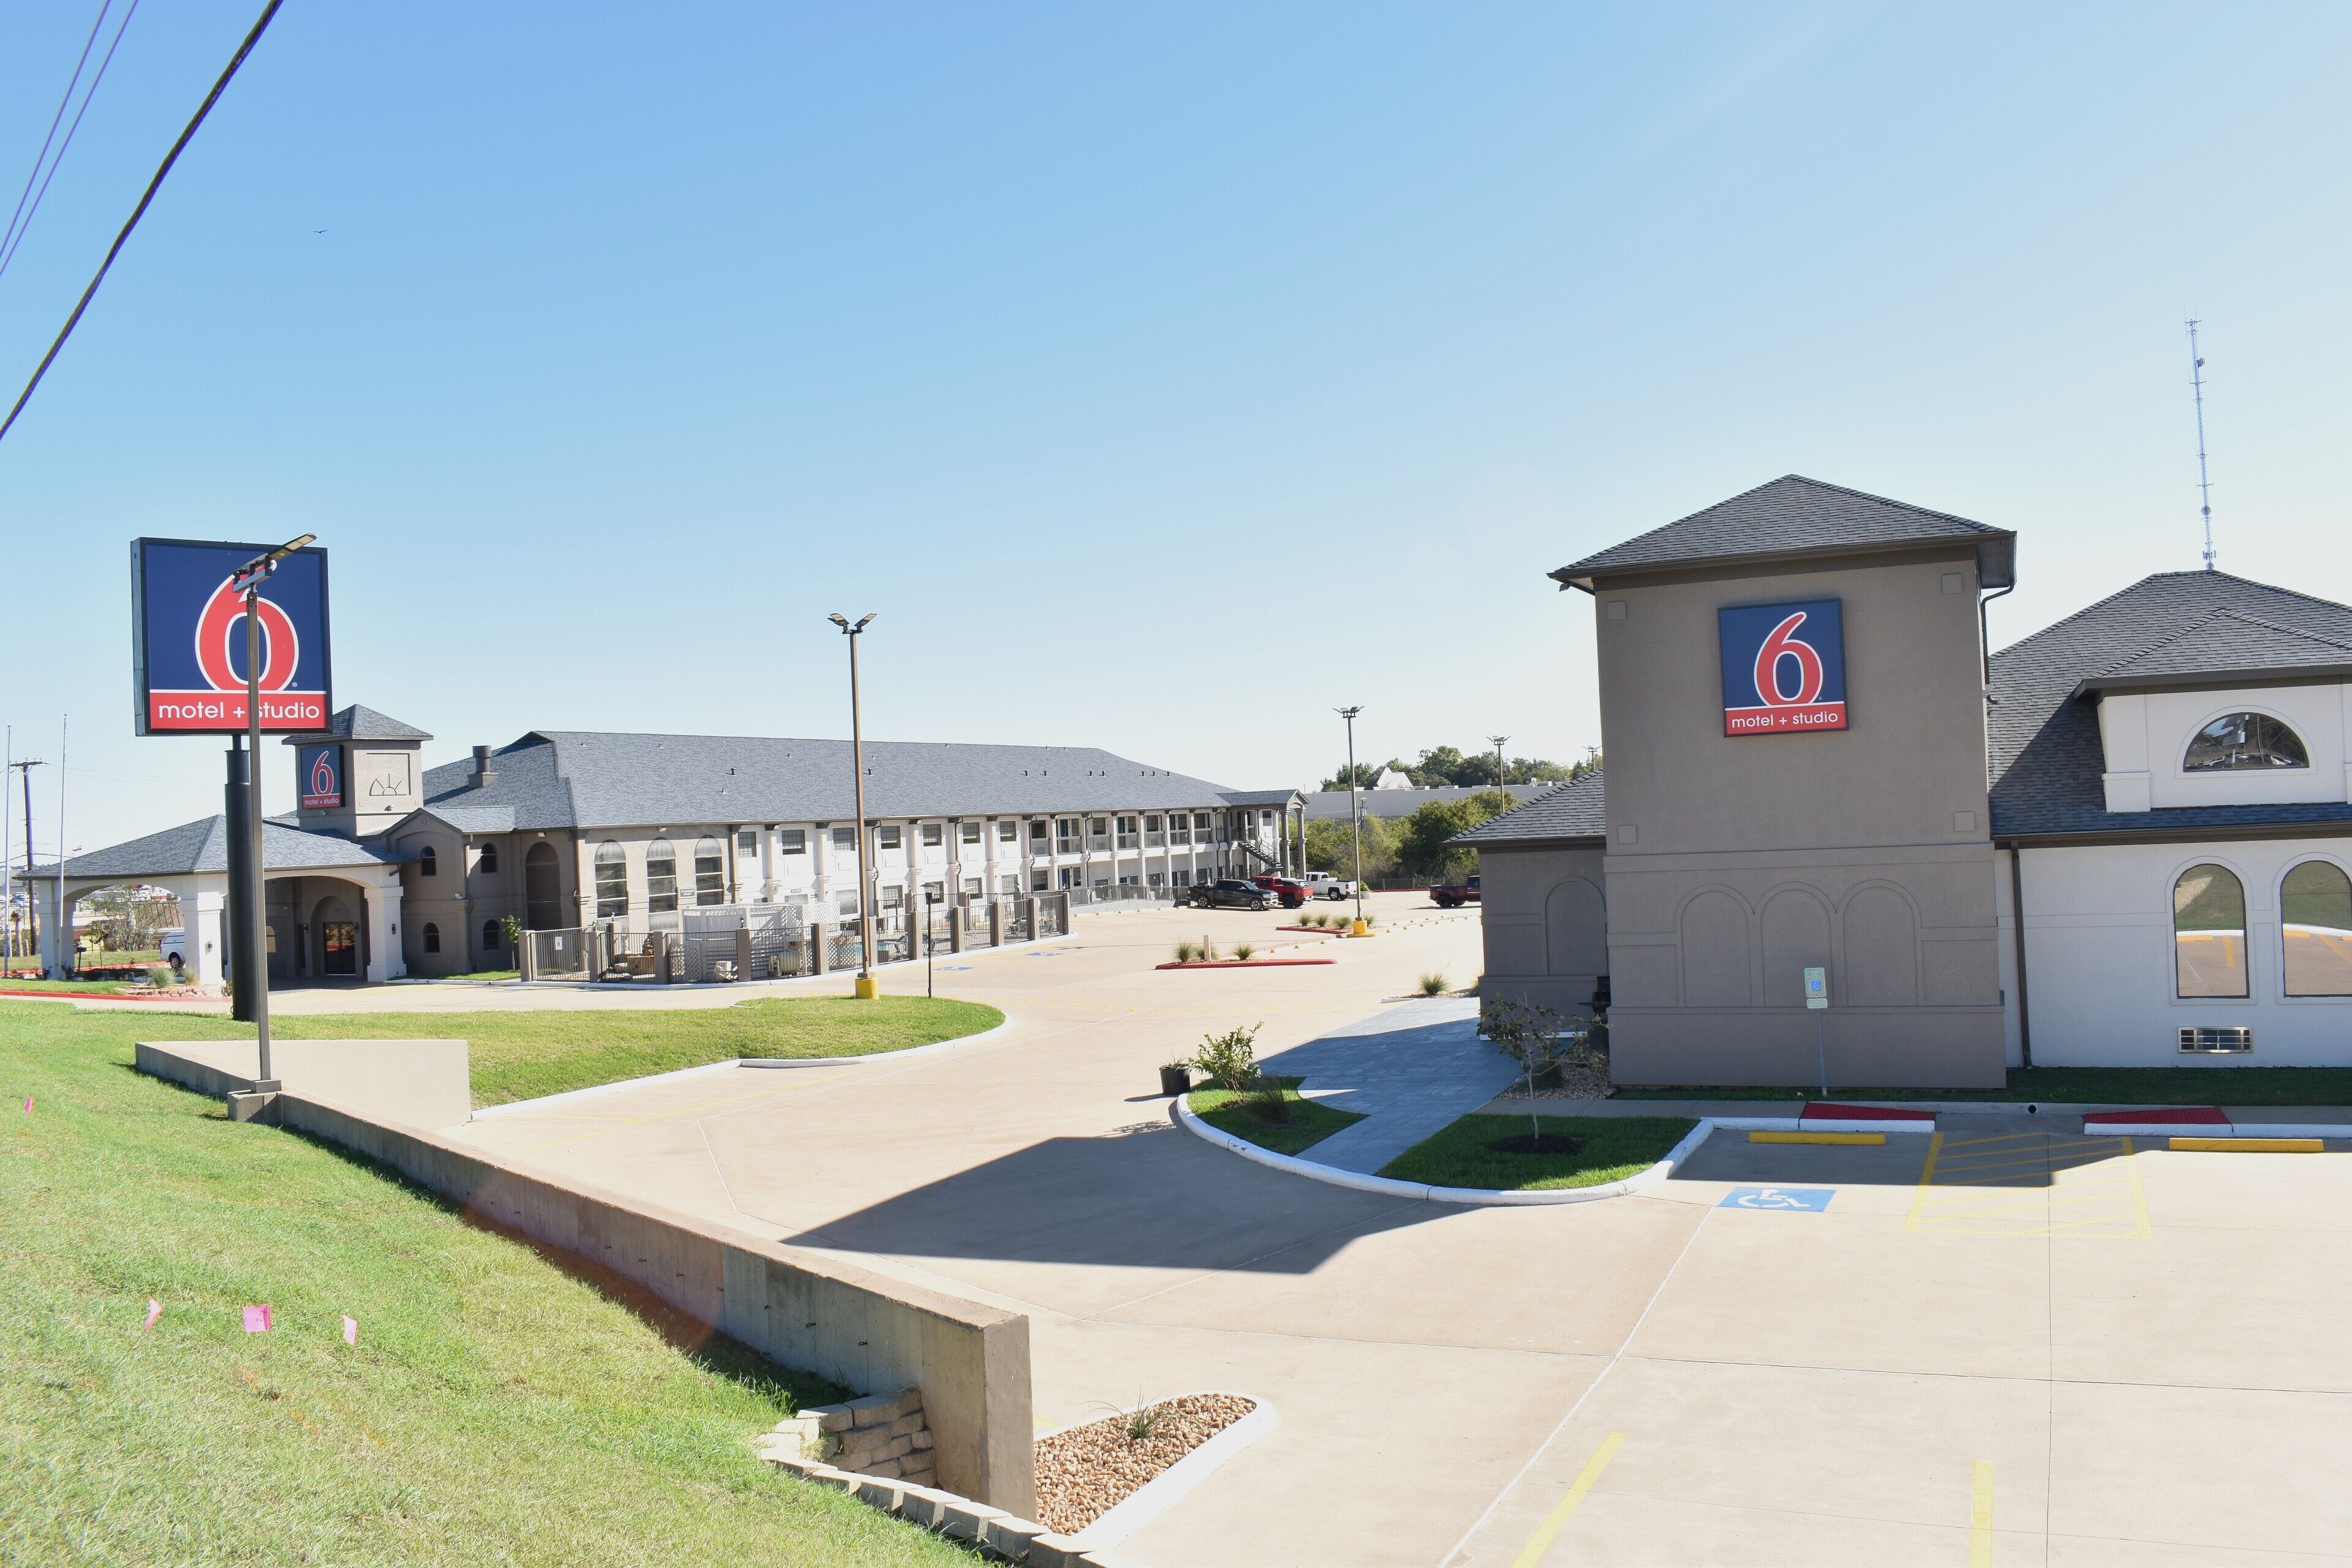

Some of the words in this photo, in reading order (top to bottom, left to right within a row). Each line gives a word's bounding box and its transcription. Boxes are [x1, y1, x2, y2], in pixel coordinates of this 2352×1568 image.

[195, 559, 299, 690] 6
[1754, 611, 1823, 706] 6
[159, 701, 224, 718] motel
[233, 706, 246, 718] +
[1732, 714, 1774, 728] motel
[1779, 717, 1787, 725] +
[1792, 711, 1838, 725] studio
[312, 751, 334, 795] 6
